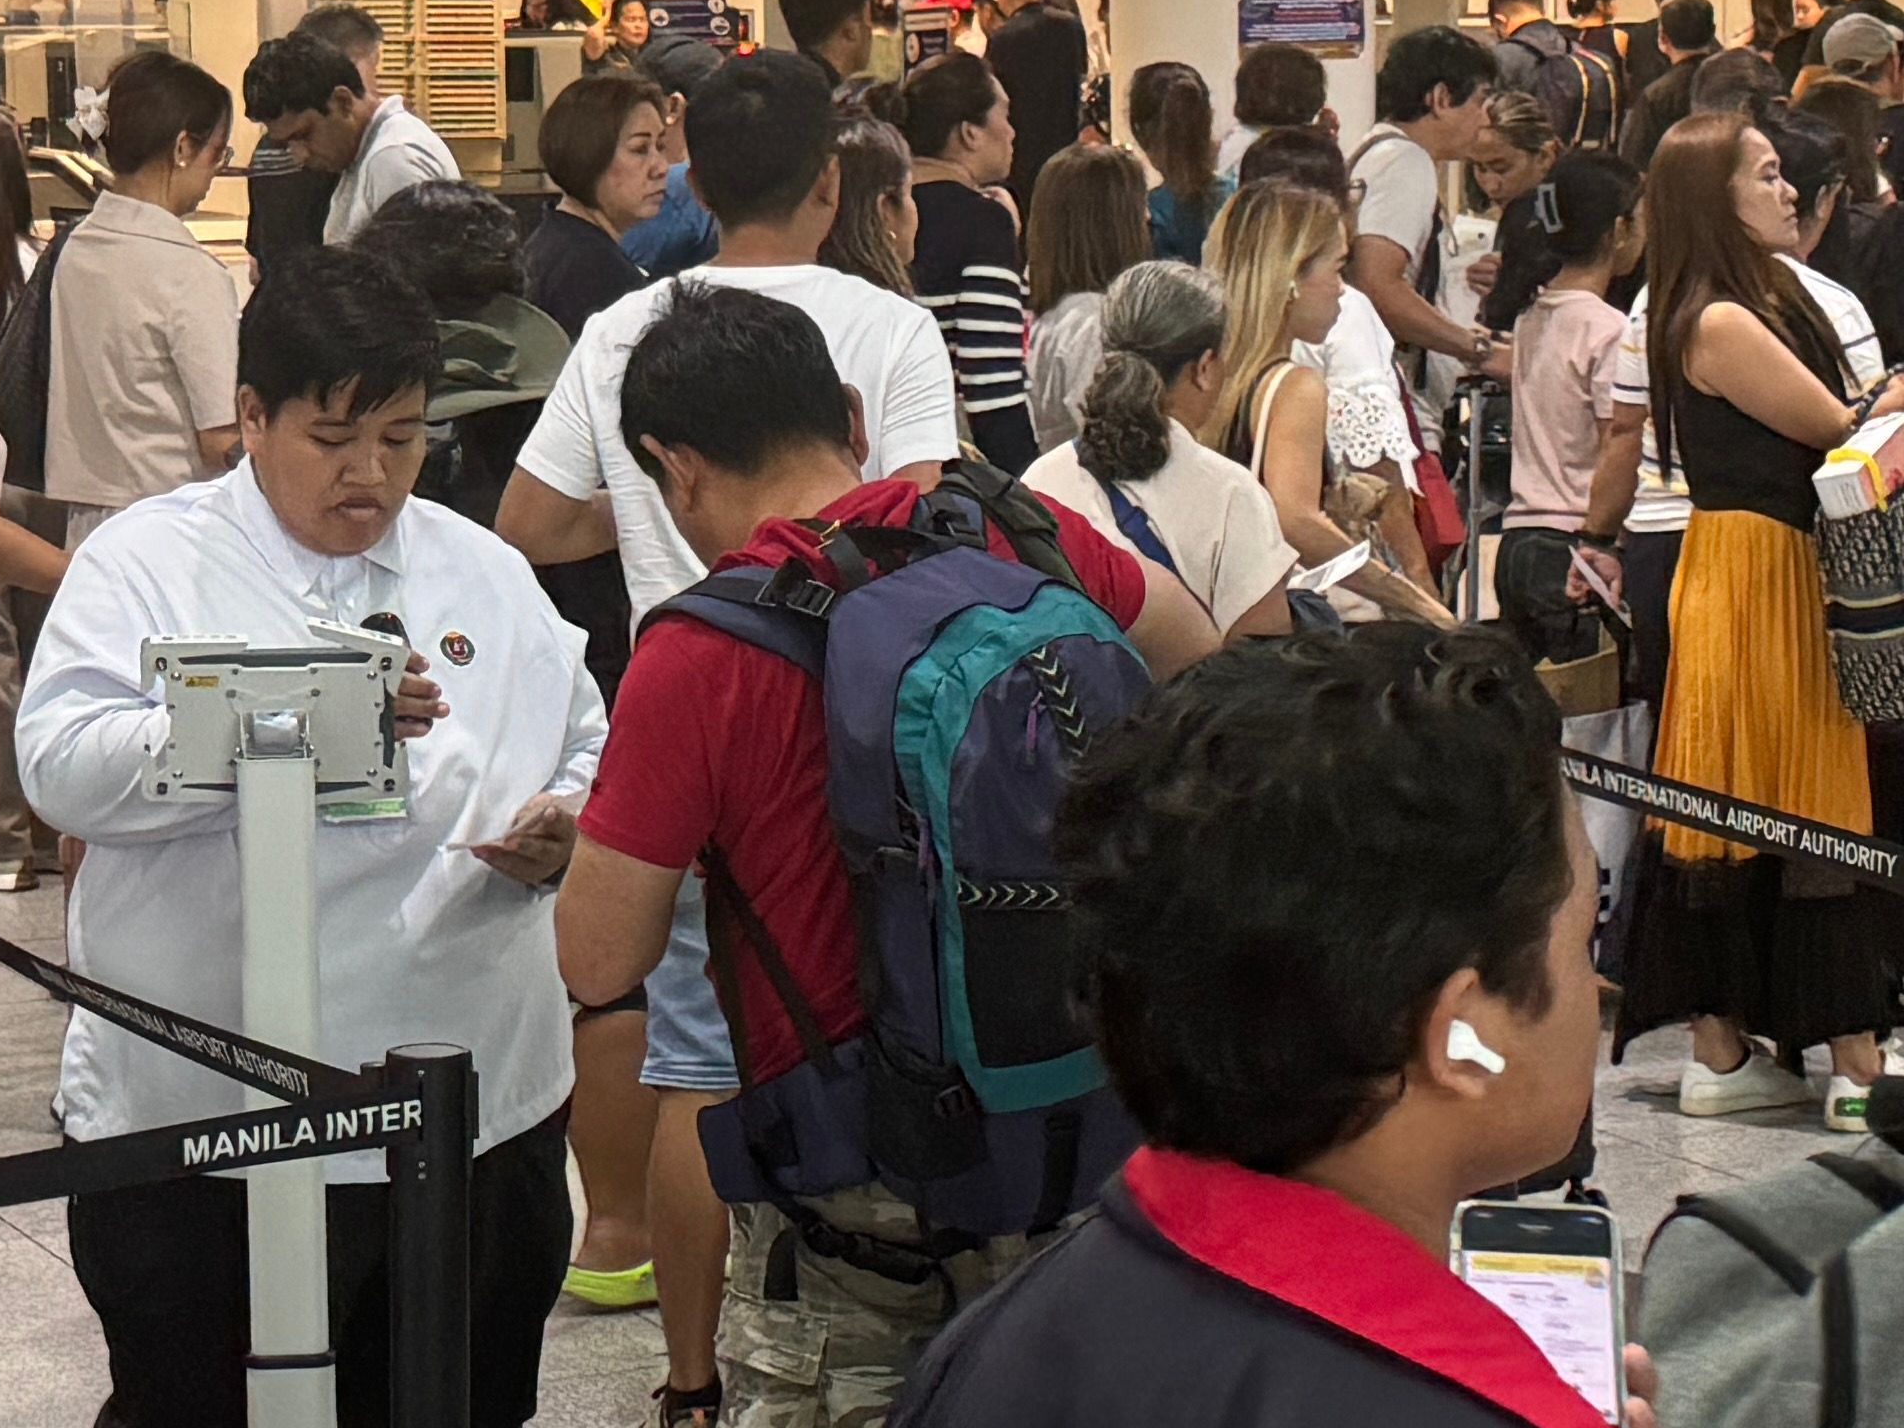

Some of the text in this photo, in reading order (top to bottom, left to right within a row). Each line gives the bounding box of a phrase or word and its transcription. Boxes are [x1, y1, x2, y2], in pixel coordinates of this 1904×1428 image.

[1603, 772, 1722, 824] INTERNATIONAL
[1726, 807, 1798, 847] AIRPORT
[1799, 829, 1897, 878] AUTHORITY
[233, 1043, 310, 1098] AUTHORITY
[183, 1099, 422, 1167] MANILA INTER
